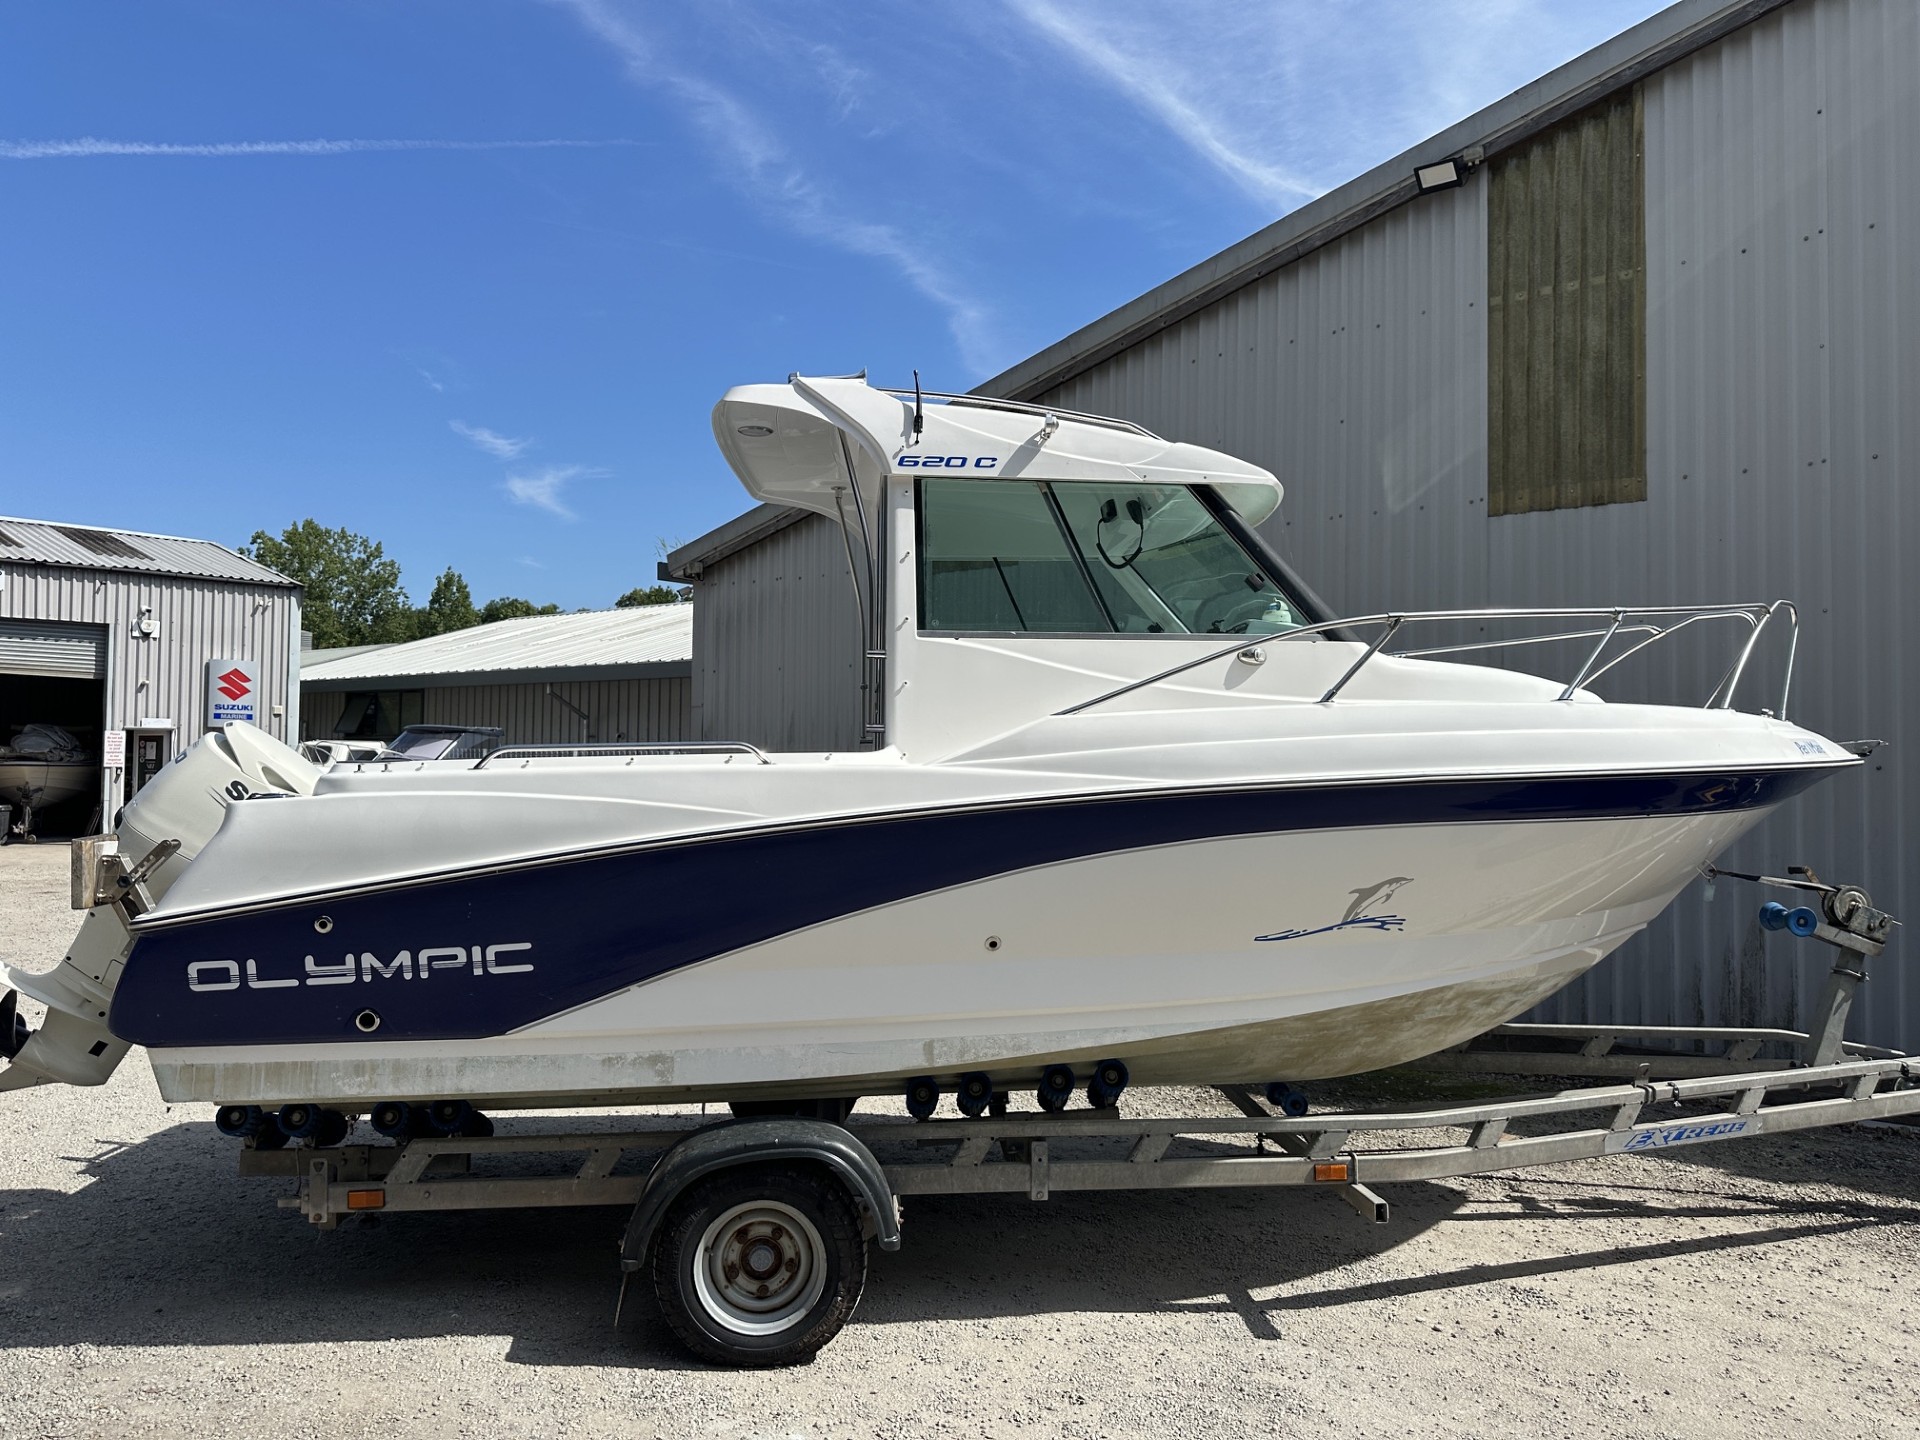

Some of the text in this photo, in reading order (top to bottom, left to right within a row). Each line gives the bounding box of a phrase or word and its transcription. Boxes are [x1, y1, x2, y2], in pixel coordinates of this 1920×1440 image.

[897, 455, 998, 468] 620 C
[214, 703, 253, 711] SUZUKI
[187, 942, 534, 992] OLYMPIC
[1624, 1121, 1747, 1151] EXTREME
